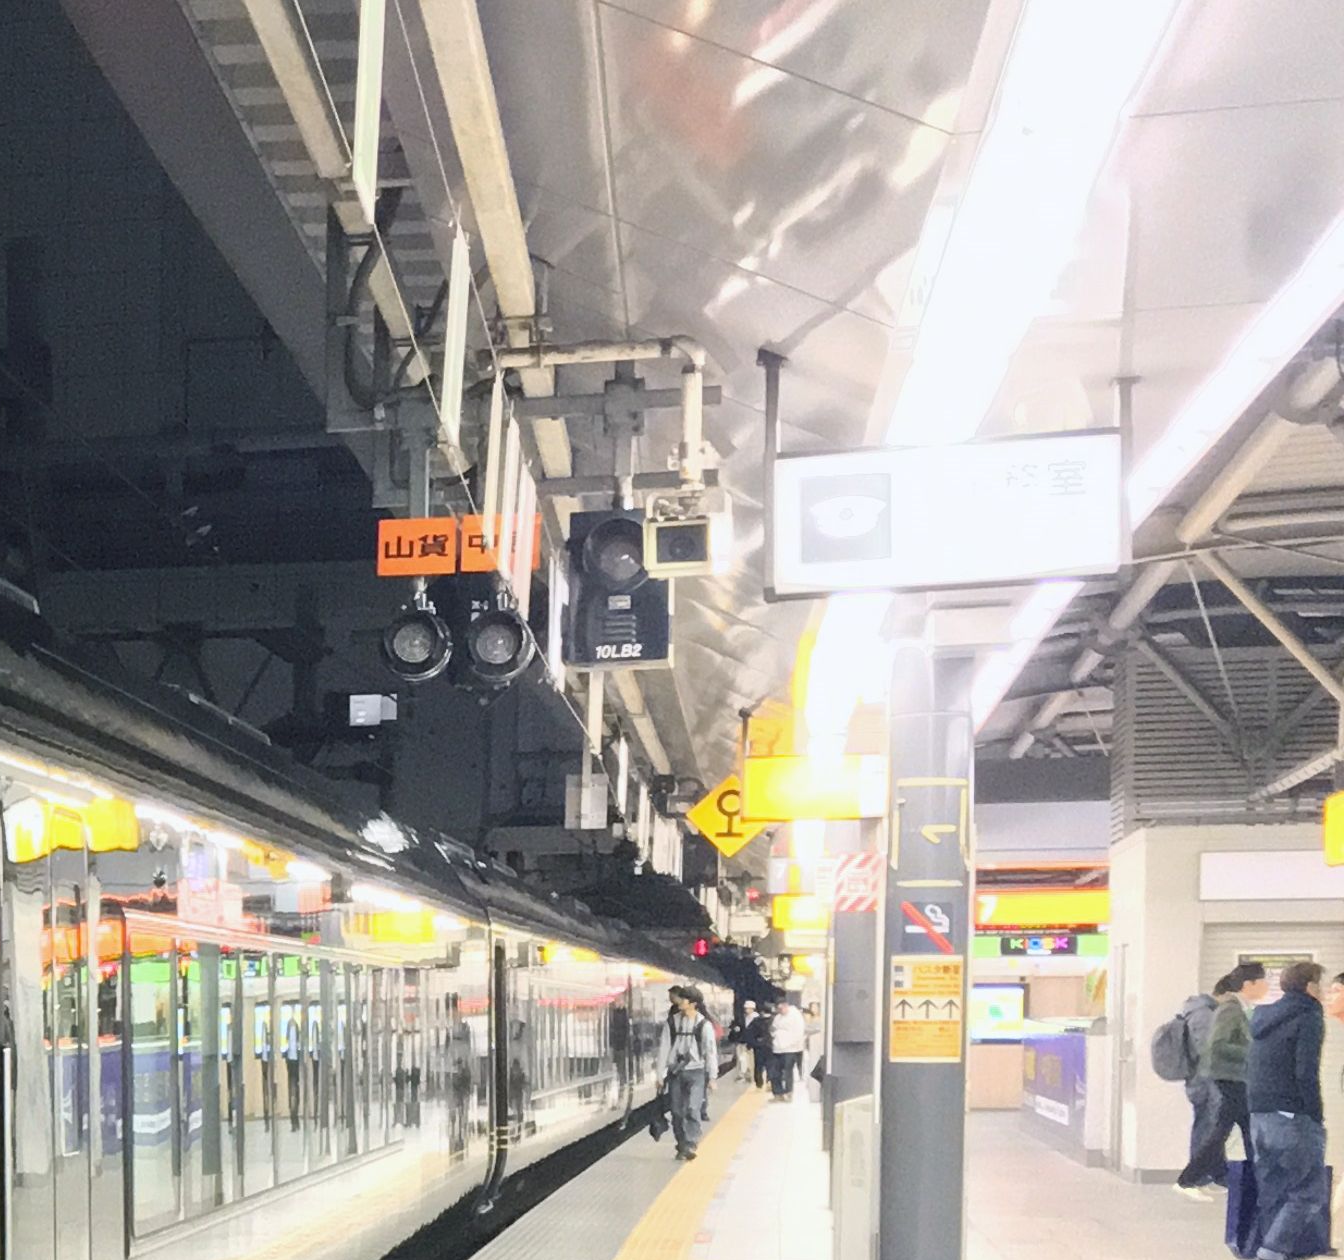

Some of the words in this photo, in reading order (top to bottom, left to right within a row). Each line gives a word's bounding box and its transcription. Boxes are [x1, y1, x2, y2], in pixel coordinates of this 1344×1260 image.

[385, 534, 449, 558] 山貨
[595, 643, 643, 660] 10LB2
[1010, 936, 1069, 950] KIOSK
